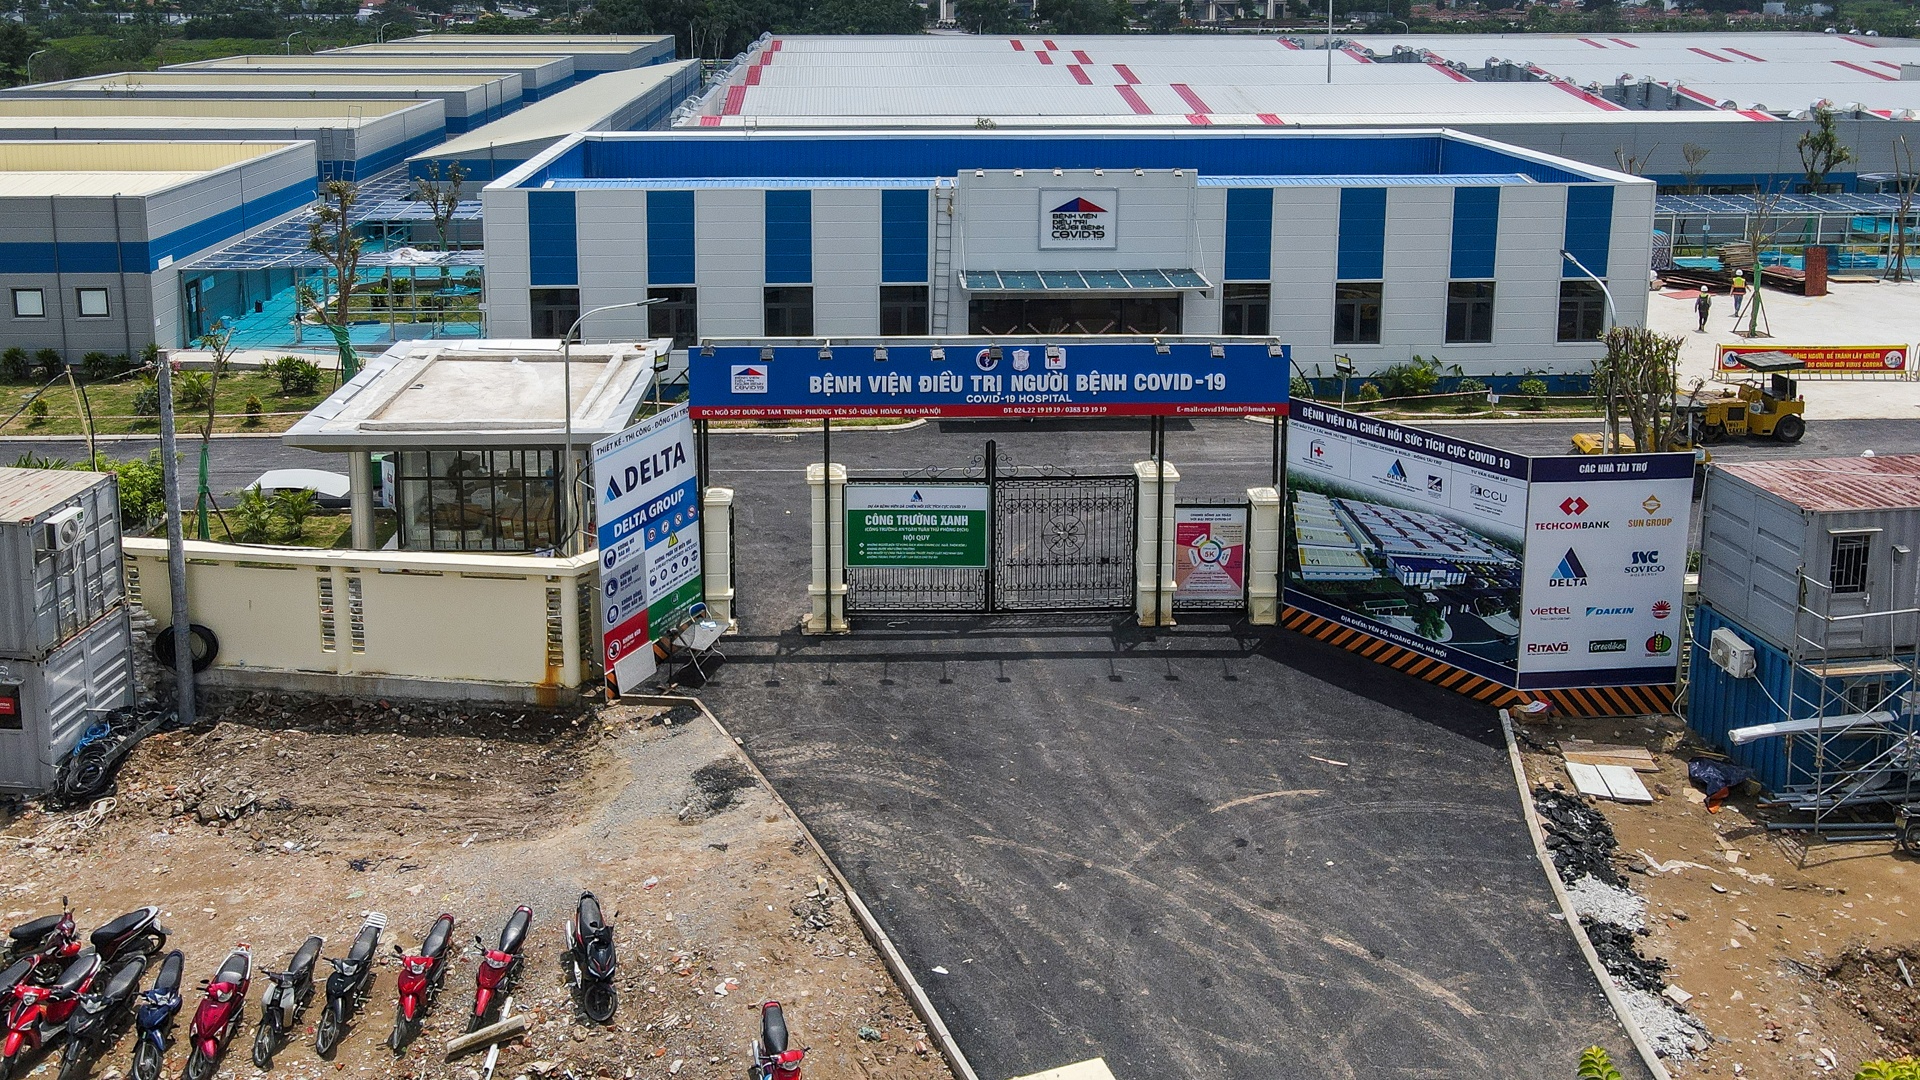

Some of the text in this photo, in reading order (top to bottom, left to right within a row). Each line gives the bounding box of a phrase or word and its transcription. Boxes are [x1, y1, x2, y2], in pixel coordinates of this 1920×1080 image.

[810, 372, 862, 397] BỆNH
[868, 371, 912, 397] VIỆN
[918, 370, 963, 393] ĐIỀU
[970, 374, 1001, 396] TRỊ
[1011, 370, 1069, 393] NGƯỜI
[1076, 370, 1127, 395] BỆNH
[966, 394, 1073, 404] COVID-19 HOSPITAL
[730, 408, 741, 417] 587
[767, 408, 781, 417] TAM
[596, 442, 614, 456] THIẾT
[614, 436, 622, 448] KẾ
[625, 433, 635, 444] THI
[636, 425, 651, 438] CÔNG
[654, 416, 671, 429] ĐỒNG
[1302, 406, 1511, 470] BỆNH VIỆN DÃ CHIẾN HỒI SỨC TÍCH CỰC COVID 19
[624, 441, 686, 493] DELTA
[1579, 461, 1648, 475] CÁC NHÀ TÀI TRỢ
[613, 488, 685, 538] DELTA GROUP
[865, 512, 969, 526] CÔNG TRƯỜNG XANH
[1628, 518, 1672, 528] SUN GROUP
[1535, 521, 1610, 531] TECHCOMBANK
[903, 534, 915, 542] NỘI
[1624, 565, 1665, 574] SOVICO
[1550, 578, 1588, 587] DELTA
[1530, 606, 1571, 615] viettel
[1595, 607, 1634, 615] DAIKIN
[1341, 615, 1351, 623] ĐỊA
[1368, 624, 1379, 633] YÊN
[1390, 633, 1411, 645] HOÀNG
[1426, 645, 1435, 654] HÀ
[1435, 648, 1447, 658] NỘI
